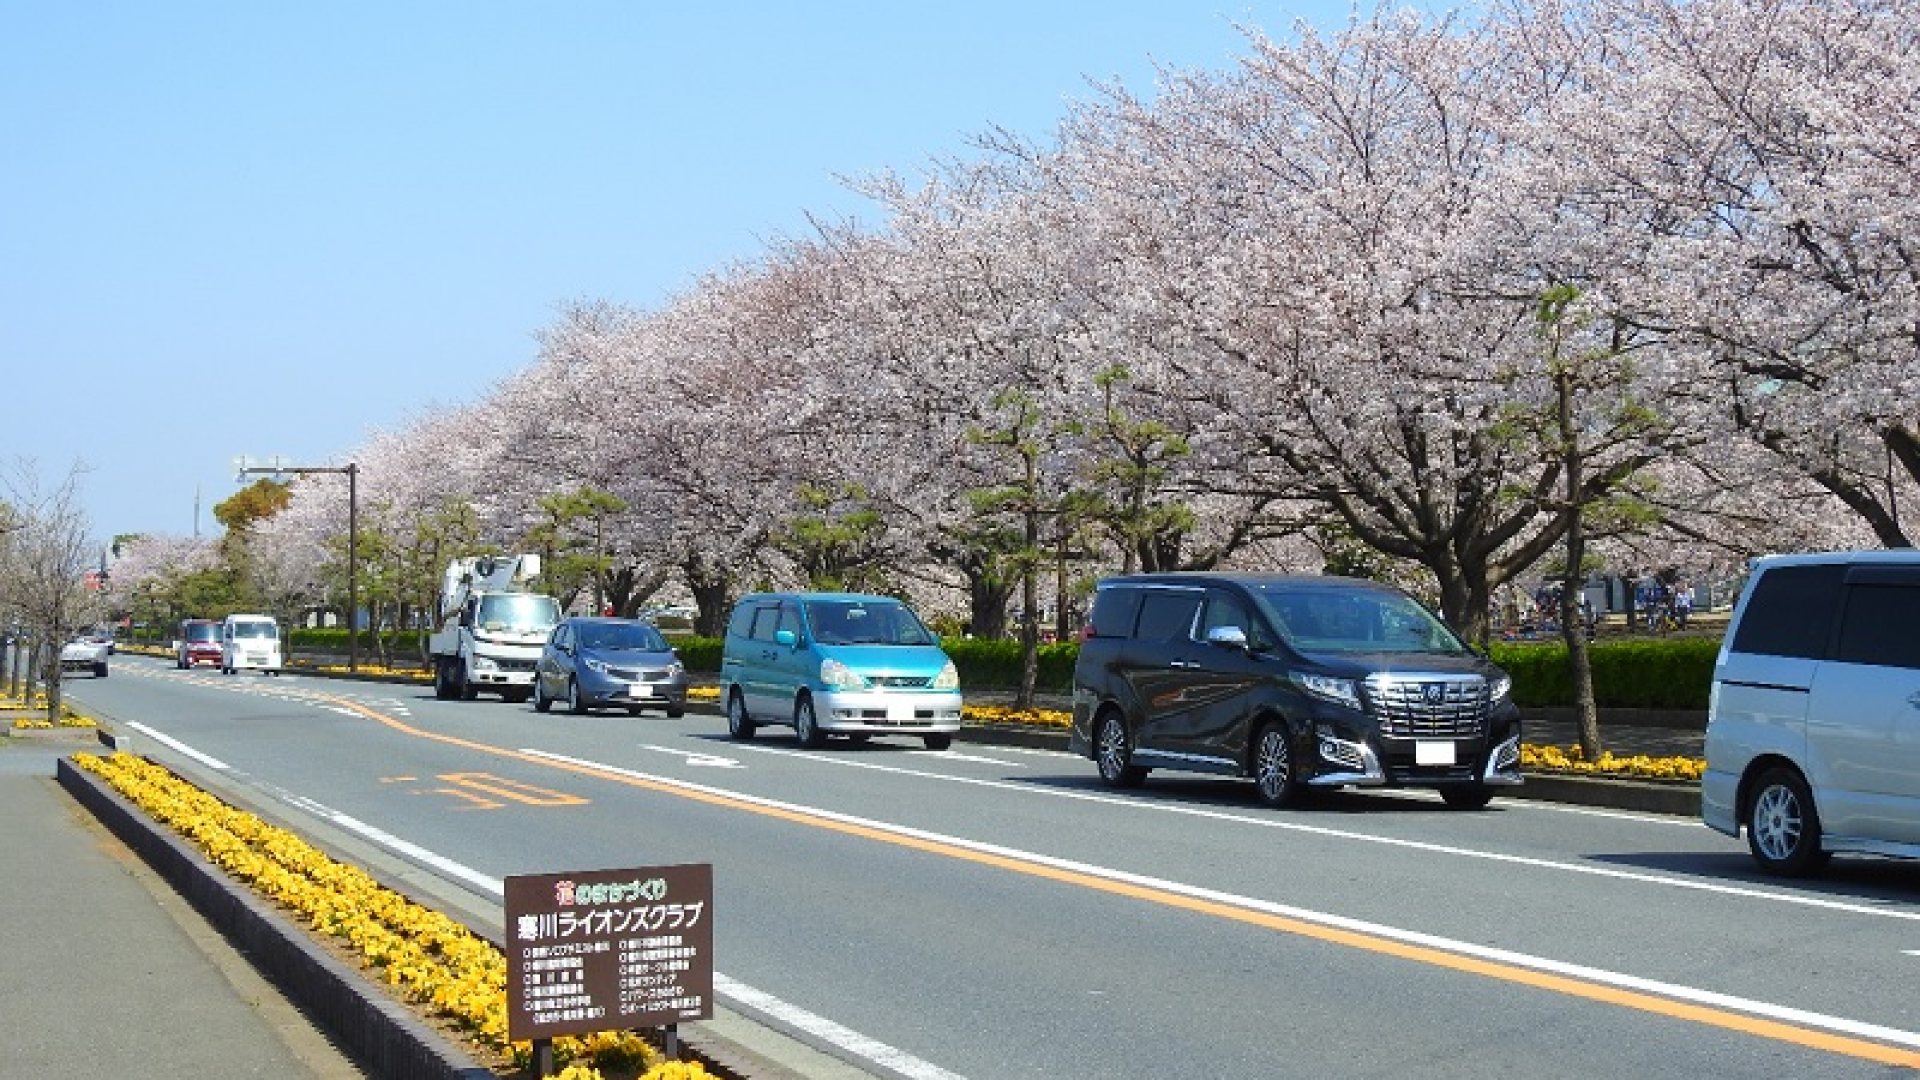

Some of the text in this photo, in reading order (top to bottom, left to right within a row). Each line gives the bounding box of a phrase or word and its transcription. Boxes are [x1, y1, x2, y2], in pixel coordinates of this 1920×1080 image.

[555, 878, 667, 905] 花のまちづくり
